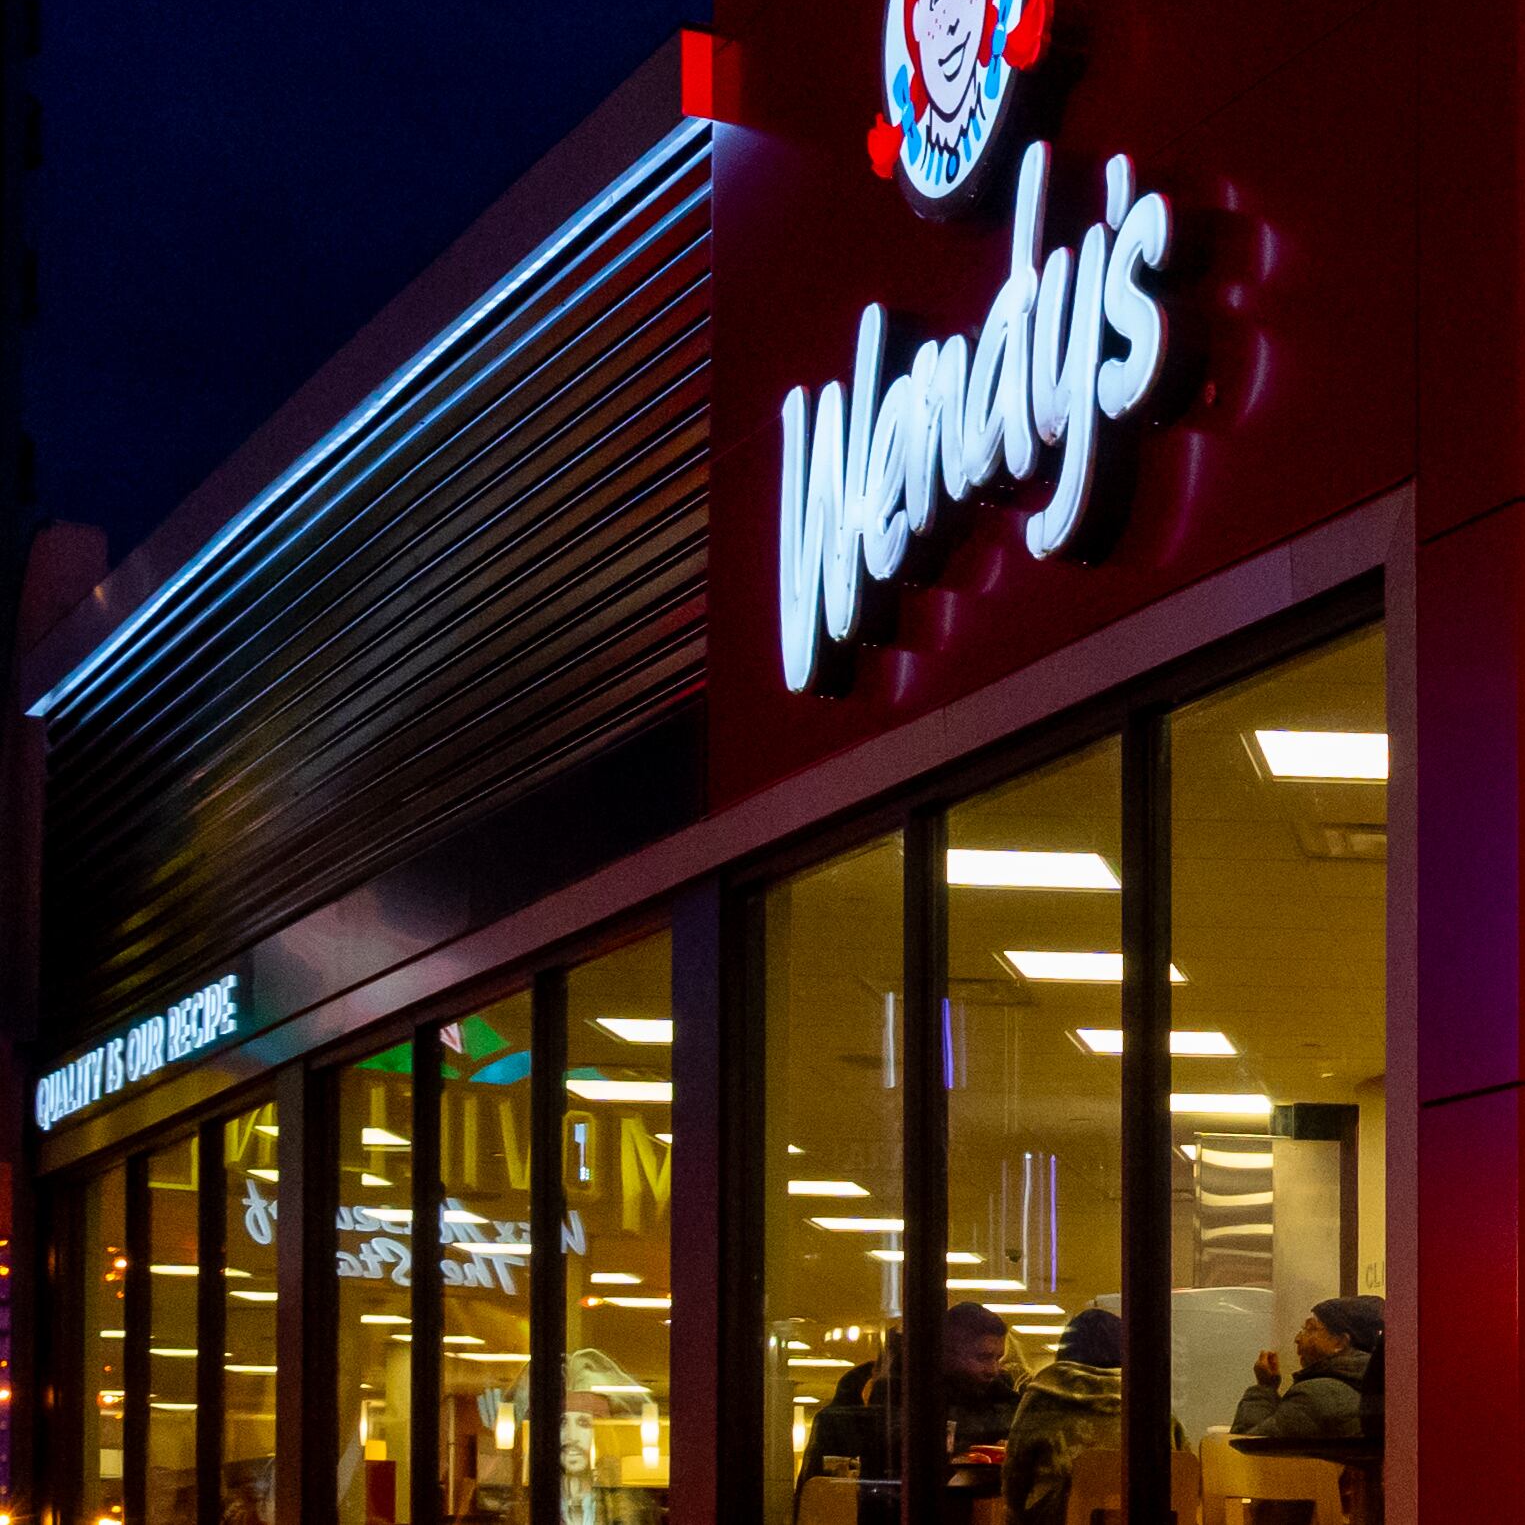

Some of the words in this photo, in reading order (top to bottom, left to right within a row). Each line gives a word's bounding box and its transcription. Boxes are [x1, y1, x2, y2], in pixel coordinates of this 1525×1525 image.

[779, 140, 1172, 692] Wendy's
[35, 1047, 105, 1131] QUALITY
[105, 1038, 124, 1094] IS
[126, 1015, 165, 1082] OUR
[167, 974, 238, 1062] RECIPE
